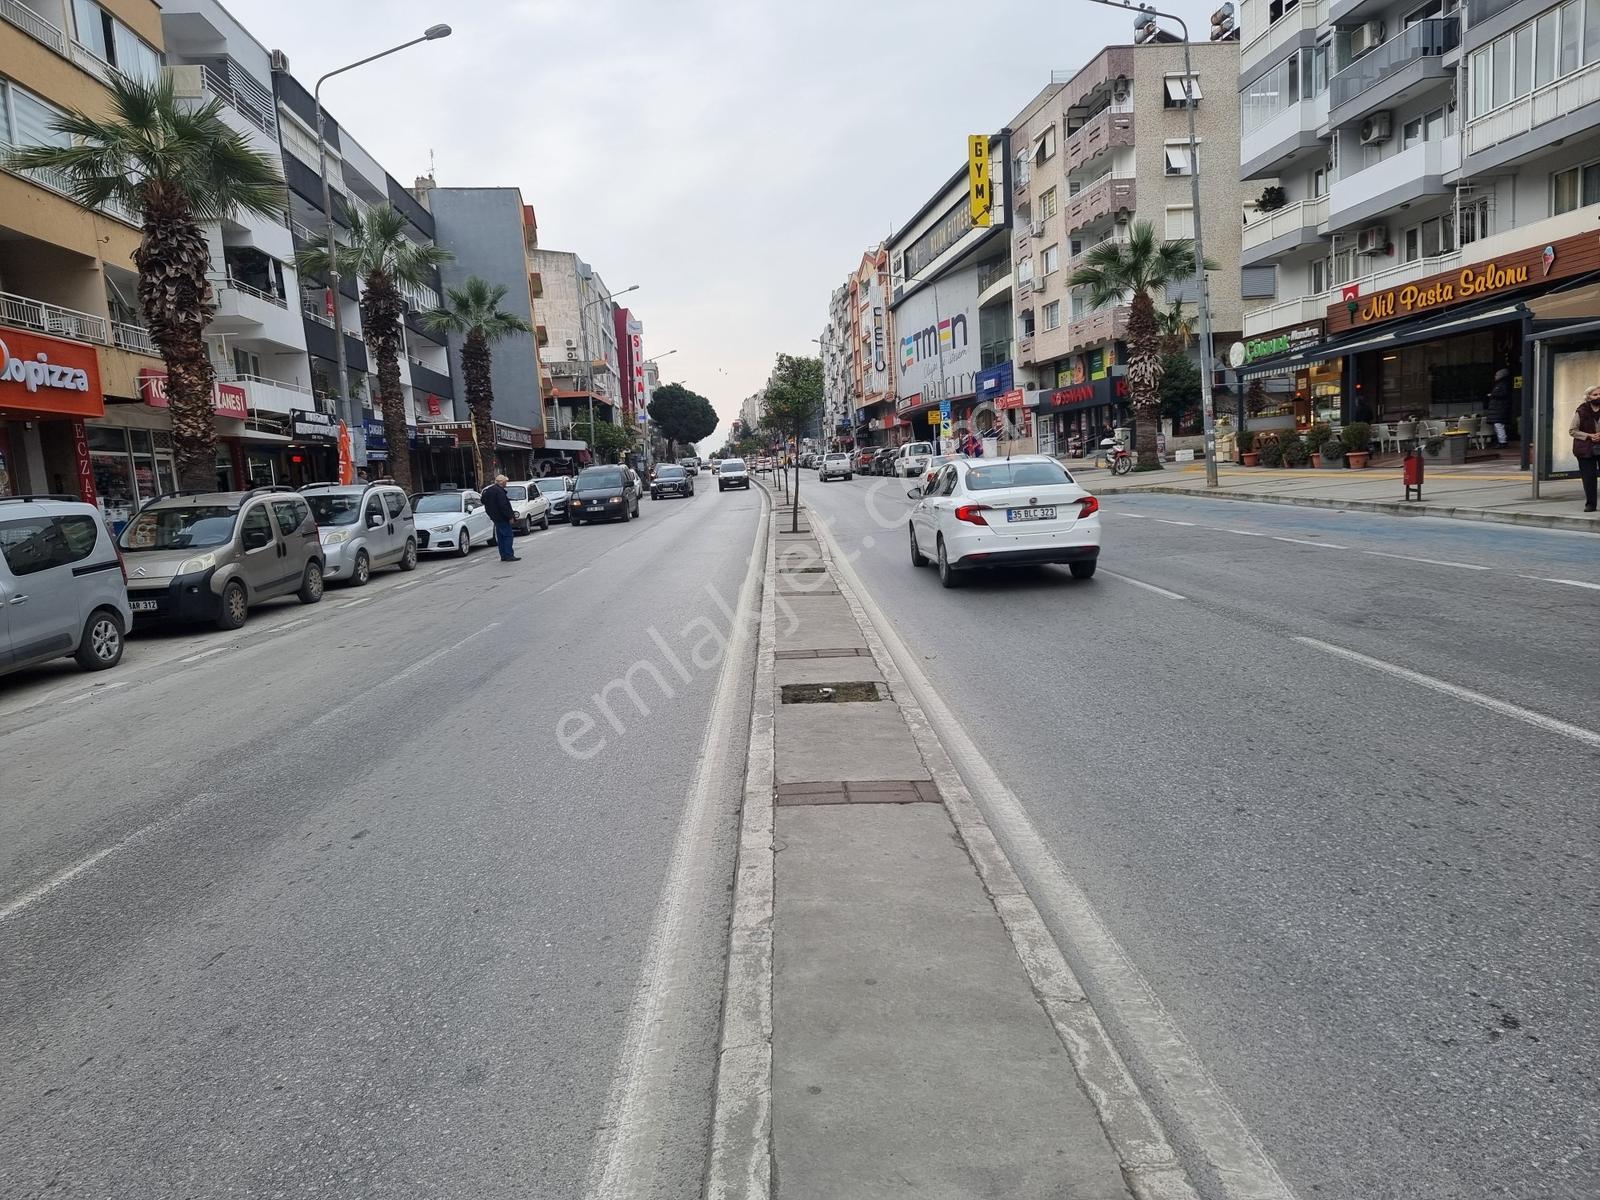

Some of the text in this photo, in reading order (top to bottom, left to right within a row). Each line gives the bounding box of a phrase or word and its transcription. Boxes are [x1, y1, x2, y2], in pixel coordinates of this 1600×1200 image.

[974, 142, 985, 199] GYM
[1363, 263, 1529, 321] Nil Pasta Salonu
[632, 334, 645, 410] SINAV
[74, 423, 93, 503] ECZA
[1012, 510, 1022, 519] 35
[1024, 509, 1038, 518] BLC
